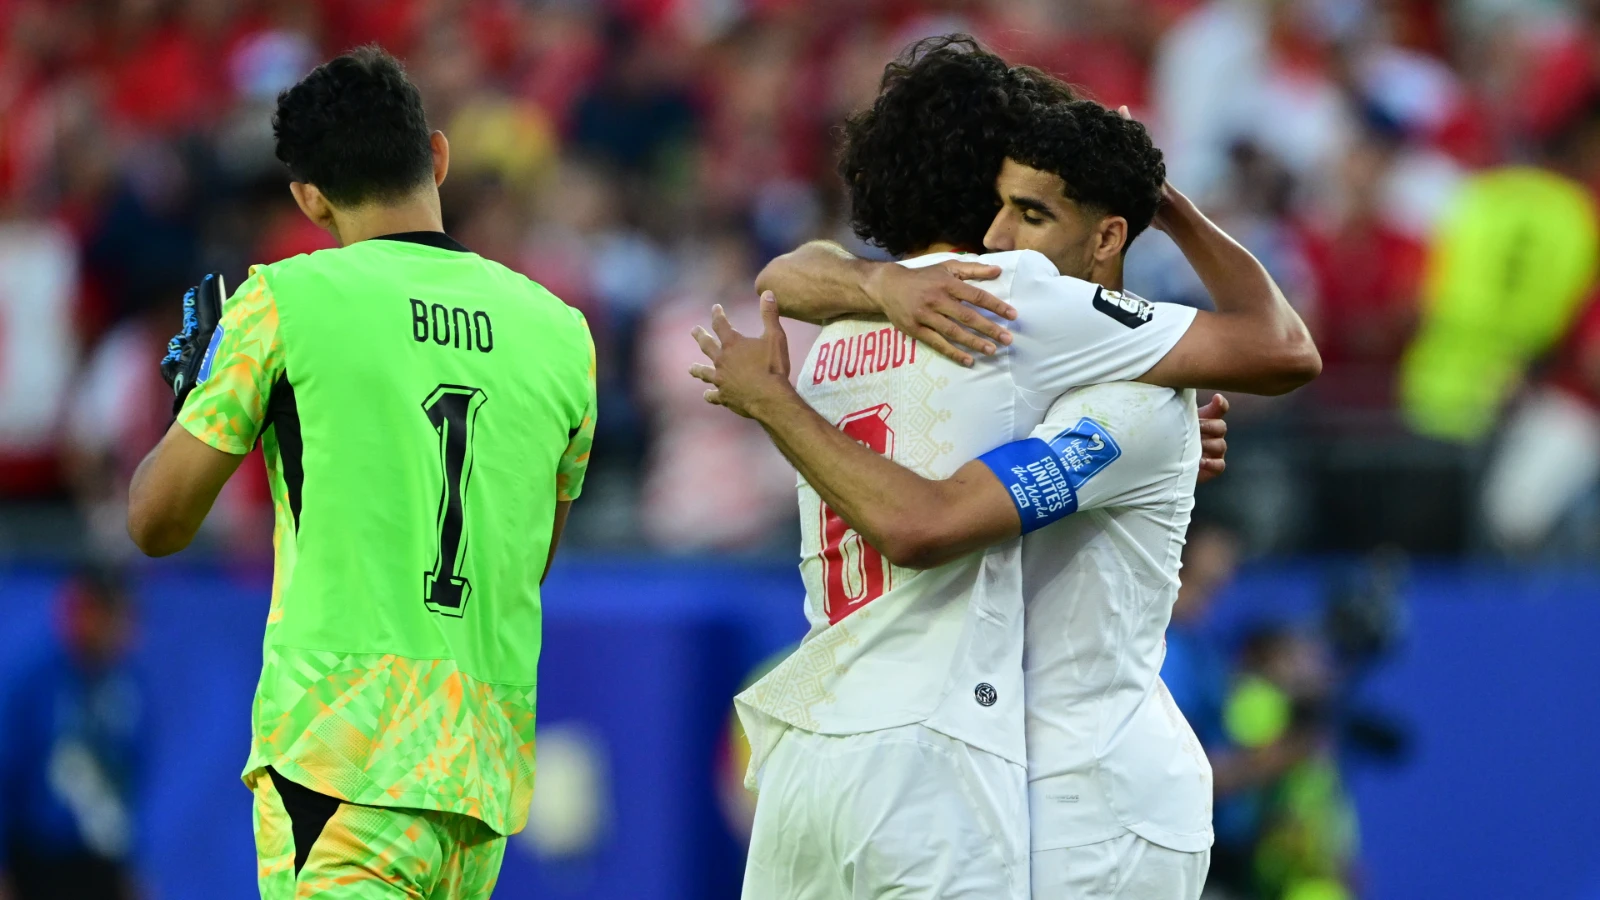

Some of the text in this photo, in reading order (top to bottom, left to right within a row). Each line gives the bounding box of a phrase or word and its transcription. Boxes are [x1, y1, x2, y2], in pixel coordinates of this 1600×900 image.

[409, 298, 493, 353] BONO
[1040, 456, 1073, 507] FOOTBALL
[1060, 457, 1071, 471] FIFA
[1062, 445, 1084, 472] PEACE
[421, 383, 488, 618] 1
[1011, 465, 1049, 519] the World
[1012, 485, 1028, 506] FIFA
[1026, 462, 1062, 512] UNITES
